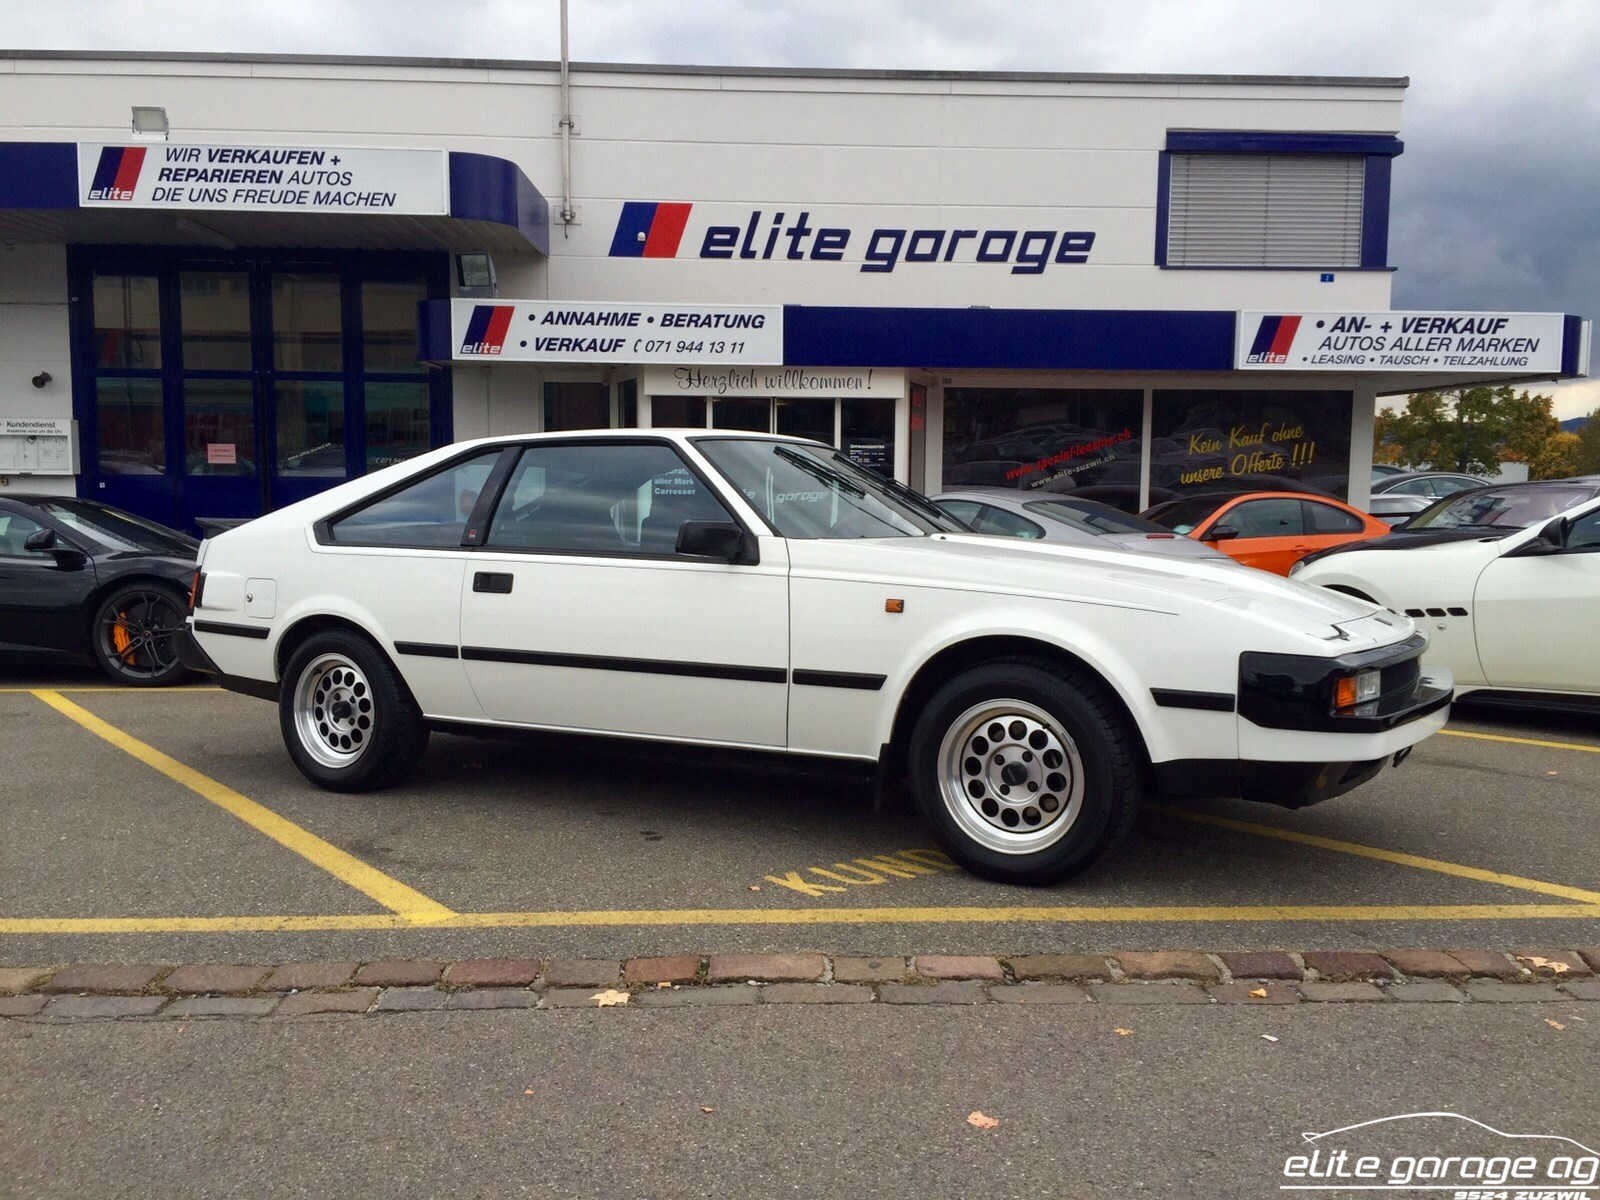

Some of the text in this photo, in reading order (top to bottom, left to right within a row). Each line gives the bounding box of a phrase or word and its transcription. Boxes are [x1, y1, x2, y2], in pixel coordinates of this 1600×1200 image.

[165, 147, 201, 163] WIR
[207, 148, 326, 166] VERKAUFEN
[158, 167, 353, 186] REPARIEREN AUTOS
[89, 187, 133, 200] elite
[152, 187, 397, 207] DIE UNS FREUDE MACHEN
[699, 211, 1096, 275] elite garage
[541, 311, 766, 329] ANNAHME BERATUNG
[1329, 316, 1372, 333] AN-
[1401, 316, 1509, 334] VERKAUF
[461, 341, 501, 354] elite
[535, 336, 745, 354] VERKAUF 071 944 13 11
[1318, 336, 1541, 353] AUTOS ALLER MARKEN
[1248, 352, 1287, 364] elite
[1311, 354, 1529, 367] LEASING TAUSCH TEILZAHLUNG
[673, 367, 873, 395] Herzlich willkommen!
[1188, 422, 1304, 456] Kein Kauf ohne
[1180, 466, 1224, 485] unsere
[1231, 450, 1284, 476] Offerte
